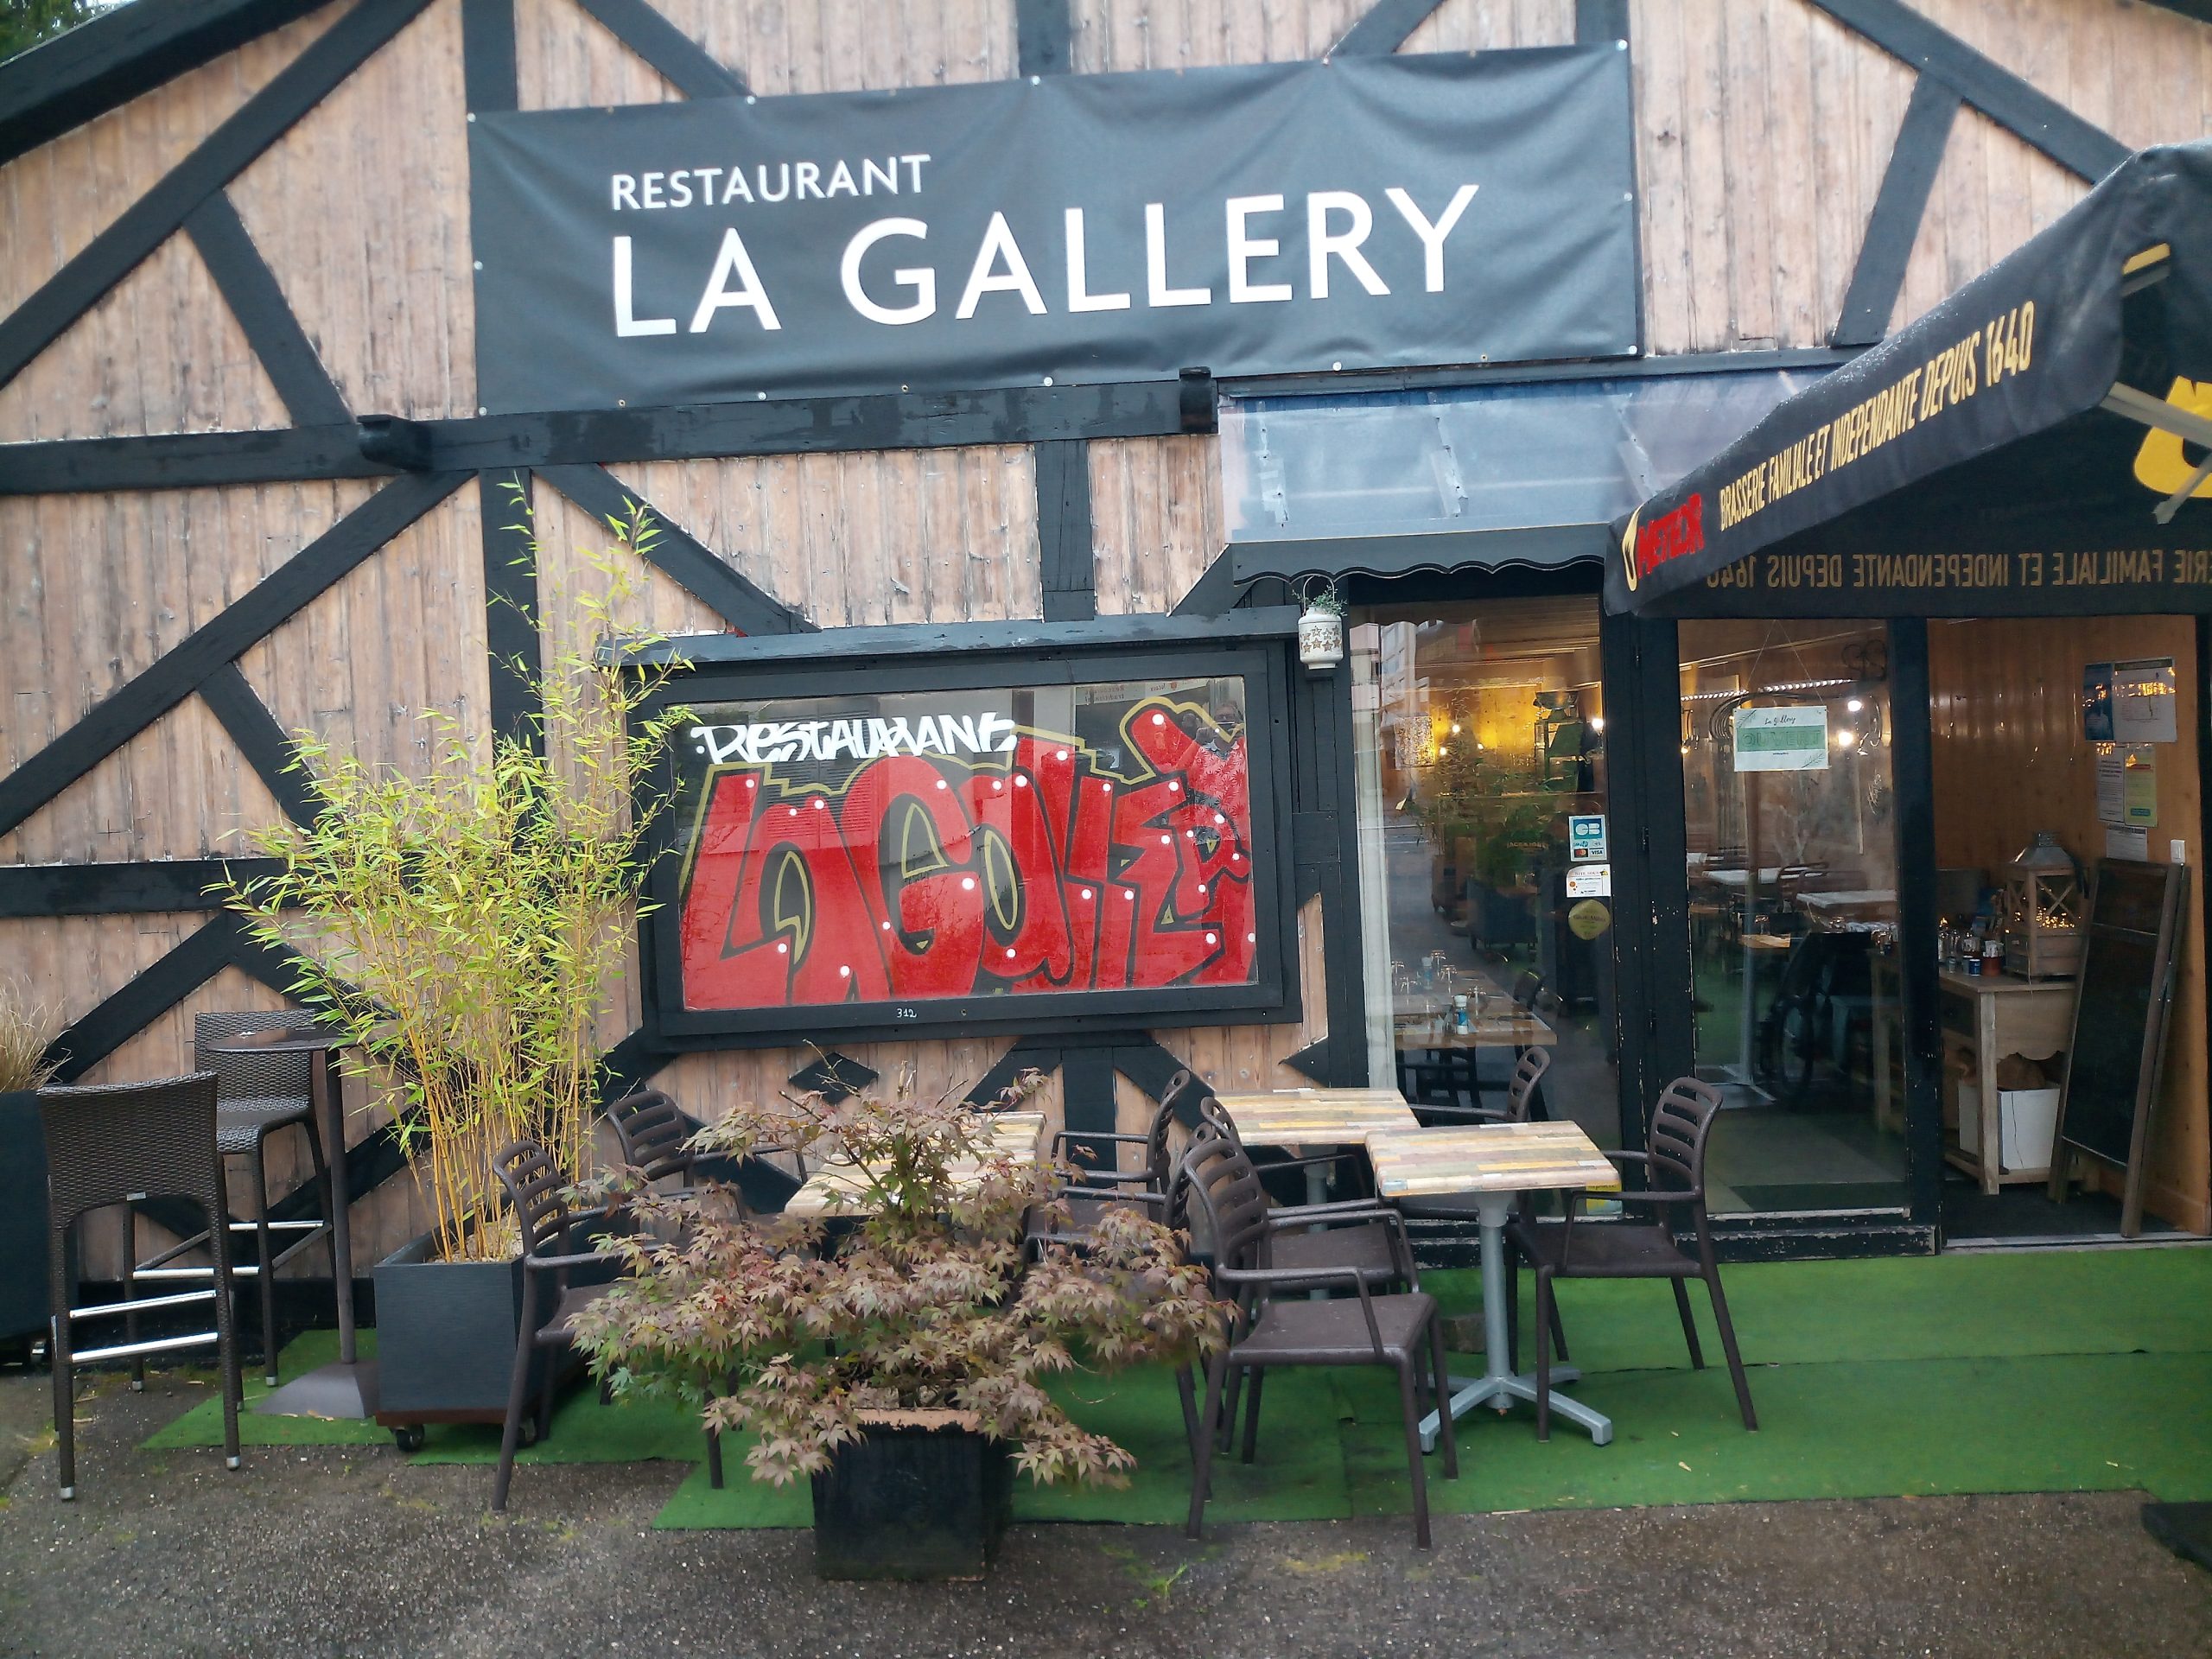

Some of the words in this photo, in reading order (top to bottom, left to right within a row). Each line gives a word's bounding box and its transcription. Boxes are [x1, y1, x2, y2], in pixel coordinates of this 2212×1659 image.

[611, 154, 931, 211] RESTAURANT
[612, 227, 783, 338] LA
[840, 184, 1479, 326] GALLERY
[1719, 461, 1768, 532] BRASSERIE
[1769, 433, 1815, 504] FAMILIALE
[1815, 423, 1831, 480] ET
[1830, 366, 1923, 473] INDEPENDANTE
[1920, 330, 1981, 423] DEPUIS
[1986, 301, 2035, 388] 1640
[1741, 729, 1821, 747] OUVERT
[896, 1007, 918, 1018] 312
